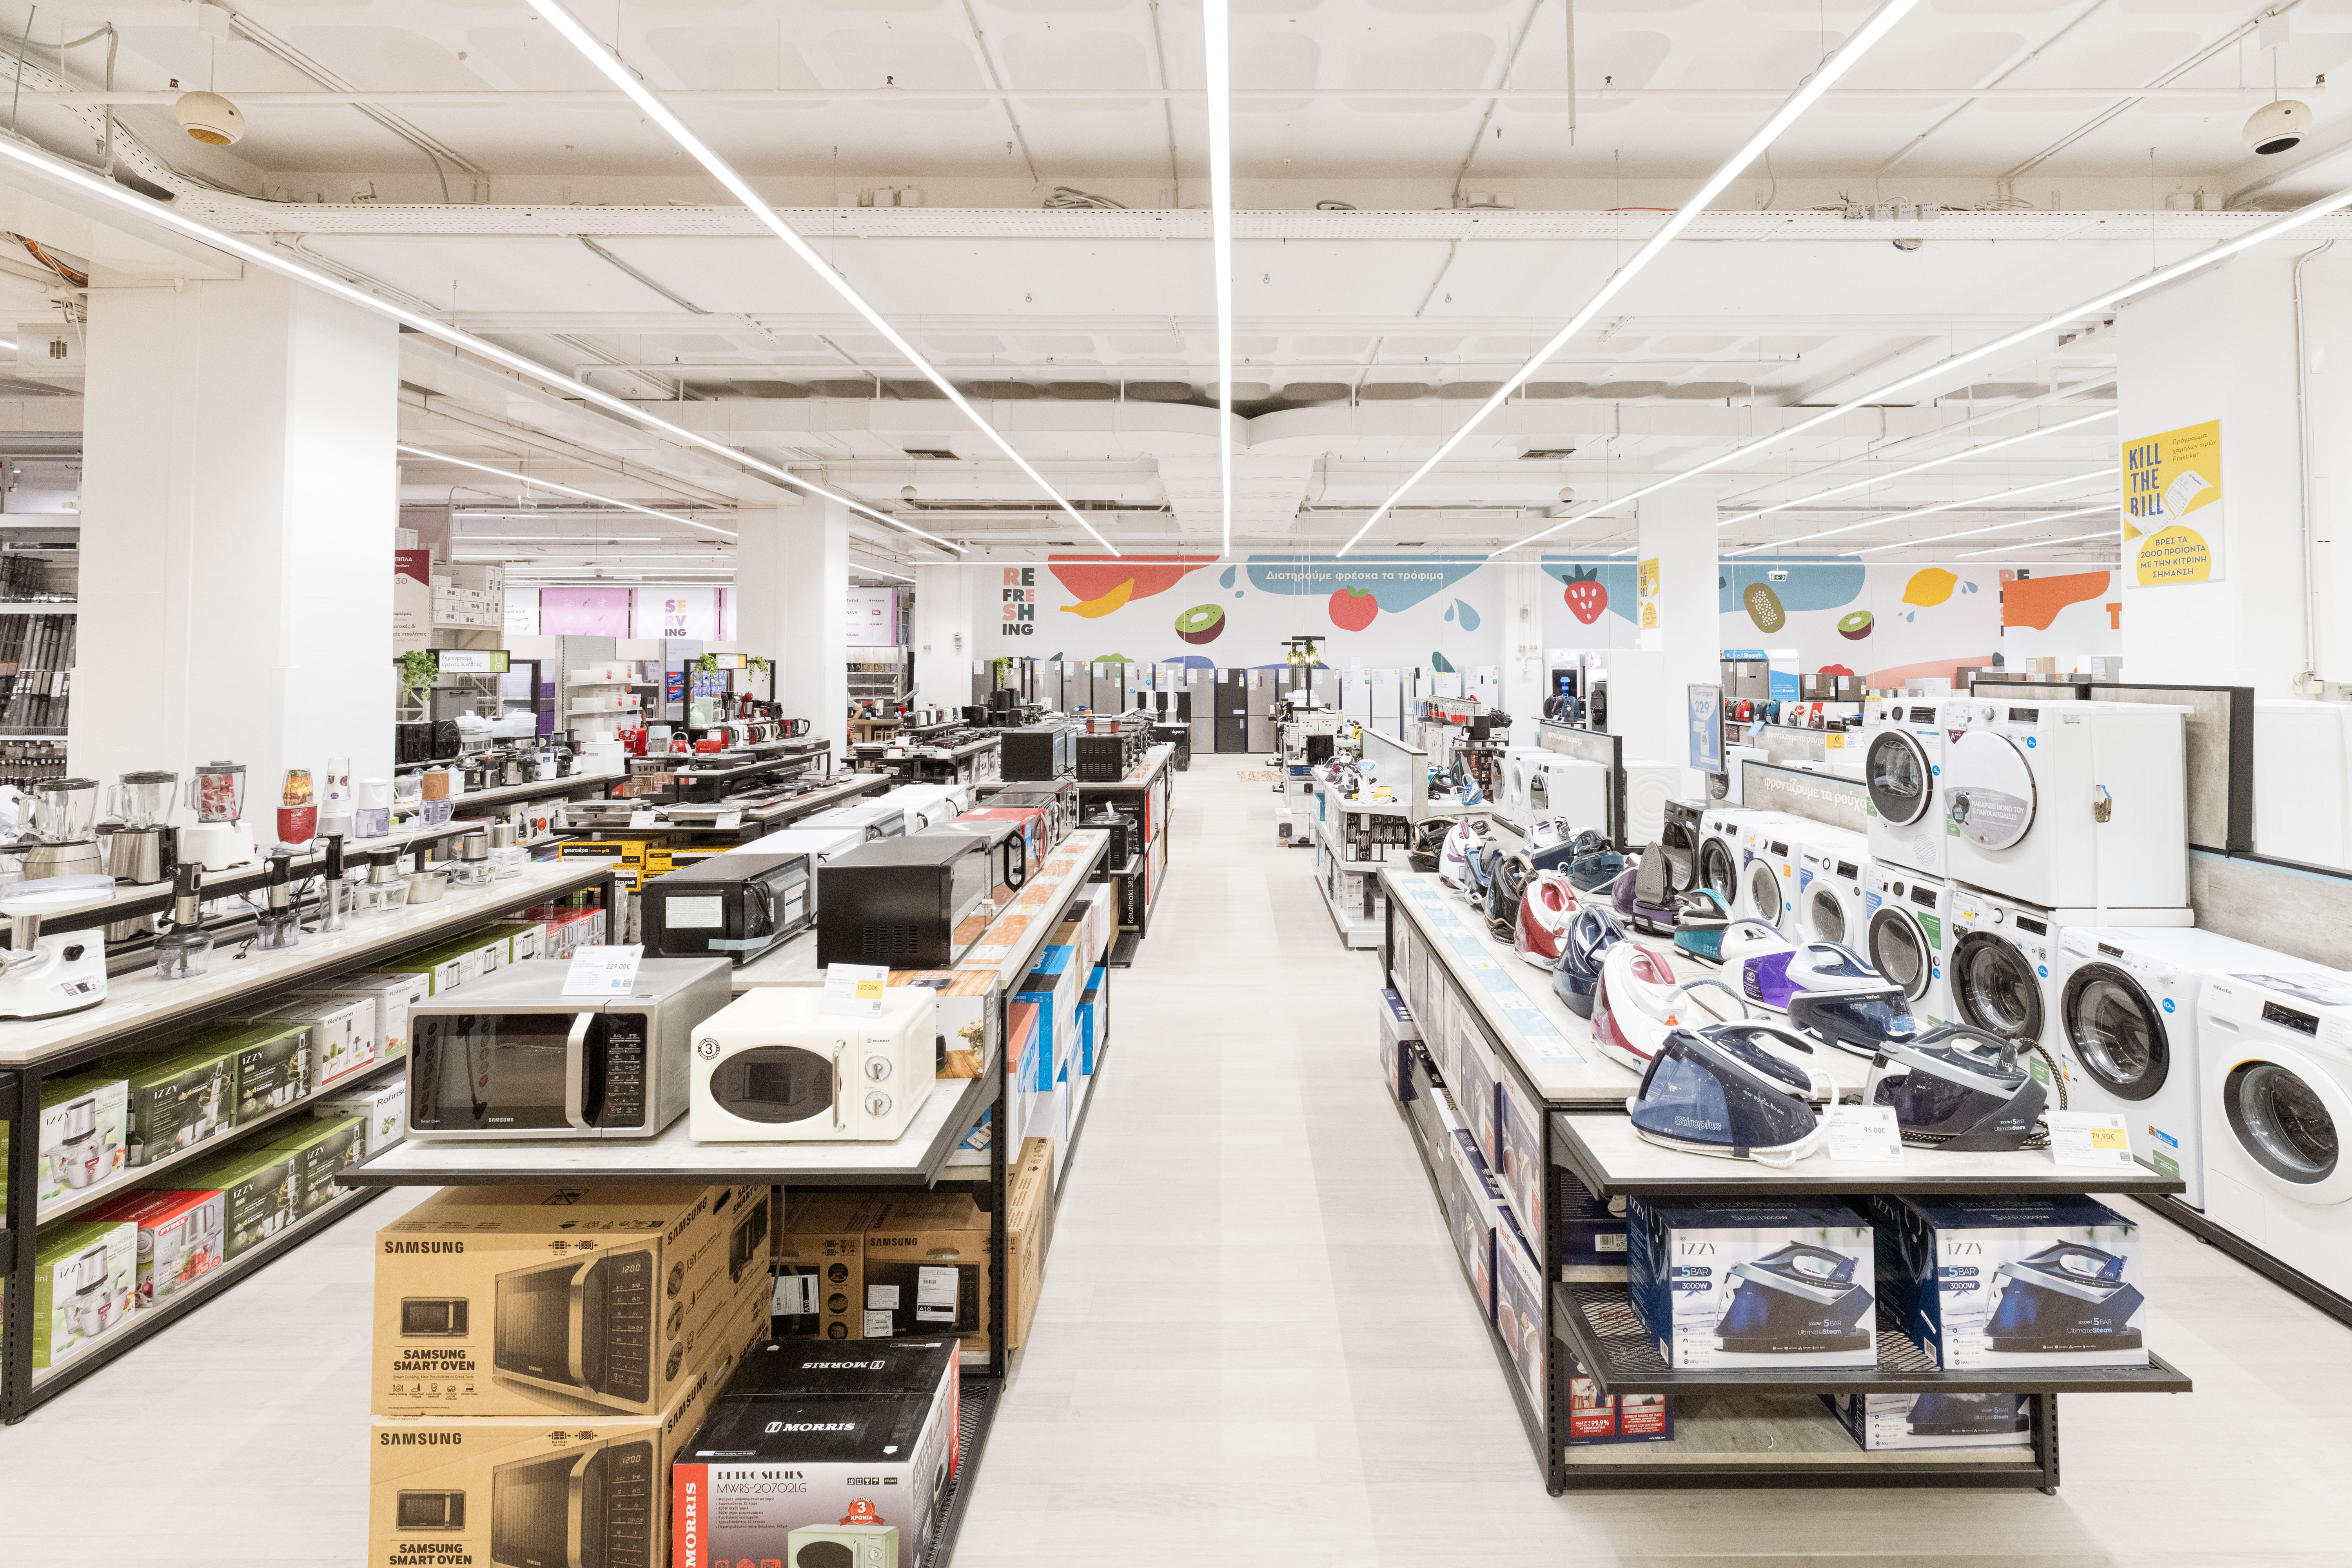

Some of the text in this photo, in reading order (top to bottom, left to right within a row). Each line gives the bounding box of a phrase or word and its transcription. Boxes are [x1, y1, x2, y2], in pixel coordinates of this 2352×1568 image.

[2172, 433, 2207, 445] Πρόγραμμα
[2172, 440, 2216, 454] χαμηλών τιμών
[2129, 443, 2161, 470] KILL
[2173, 452, 2199, 461] Praktiker
[2131, 469, 2159, 495] THE
[2131, 493, 2163, 517] BILL
[2164, 545, 2206, 555] ΠΡΟΪΟΝΤΑ
[2173, 556, 2207, 565] ΚΙΤΡΙΝΗ
[1004, 567, 1034, 586] RE
[1266, 570, 1332, 582] Διατηρούμε
[1336, 571, 1377, 582] φρέσκα
[1398, 571, 1444, 582] τρόφιμα
[2153, 569, 2194, 578] ΣΗΜΑΝΣΗ
[1003, 589, 1034, 602] FRE
[665, 599, 686, 613] SE
[1003, 604, 1034, 621] SH
[665, 615, 686, 626] RV
[665, 628, 686, 637] ING
[1002, 624, 1033, 635] ING
[1692, 689, 1713, 698] Πλυντήρια
[1767, 731, 1798, 742] φροντίζουμε
[1807, 736, 1824, 746] ρούχα
[1764, 778, 1867, 812] φροντίζουμε τα ρούχα
[1972, 801, 1996, 810] ΚΑΘΑΡΙΖΕΙ
[1993, 811, 2016, 820] ΑΠΟΔΙΔΕΙ
[389, 985, 412, 997] Rohnson
[2212, 984, 2232, 995] Miele
[2163, 1001, 2175, 1011] 10kg
[327, 1011, 354, 1025] Rohnson
[706, 1044, 712, 1054] 3
[1717, 1041, 1731, 1052] Stiroplus
[243, 1051, 264, 1065] IZZY
[154, 1083, 179, 1099] IZZY
[46, 1111, 72, 1126] IZZY
[1675, 1115, 1722, 1131] Stiroplus
[307, 1145, 325, 1160] IZZY
[234, 1182, 254, 1199] IZZY
[1630, 1195, 1645, 1220] IZZY
[160, 1218, 185, 1235] PYREX
[668, 1196, 707, 1245] SAMSUNG
[1499, 1221, 1517, 1261] Tefal
[385, 1241, 464, 1254] SAMSUNG
[1681, 1243, 1717, 1255] IZZY
[1948, 1243, 1984, 1254] IZZY
[60, 1261, 82, 1278] IZZY
[622, 1264, 640, 1273] 12:00
[403, 1350, 466, 1359] SAMSUNG
[394, 1361, 475, 1370] SMART OVEN
[667, 1371, 708, 1435] SAMSUNG
[783, 1423, 855, 1431] MORRIS
[380, 1433, 462, 1446] SAMSUNG
[718, 1471, 803, 1479] RETRO SERIES
[717, 1483, 807, 1493] MWRS-20702LG
[857, 1501, 866, 1513] 3
[684, 1481, 697, 1568] MORRIS
[399, 1543, 463, 1553] SAMSUNG
[389, 1555, 472, 1565] SMART OVEN
